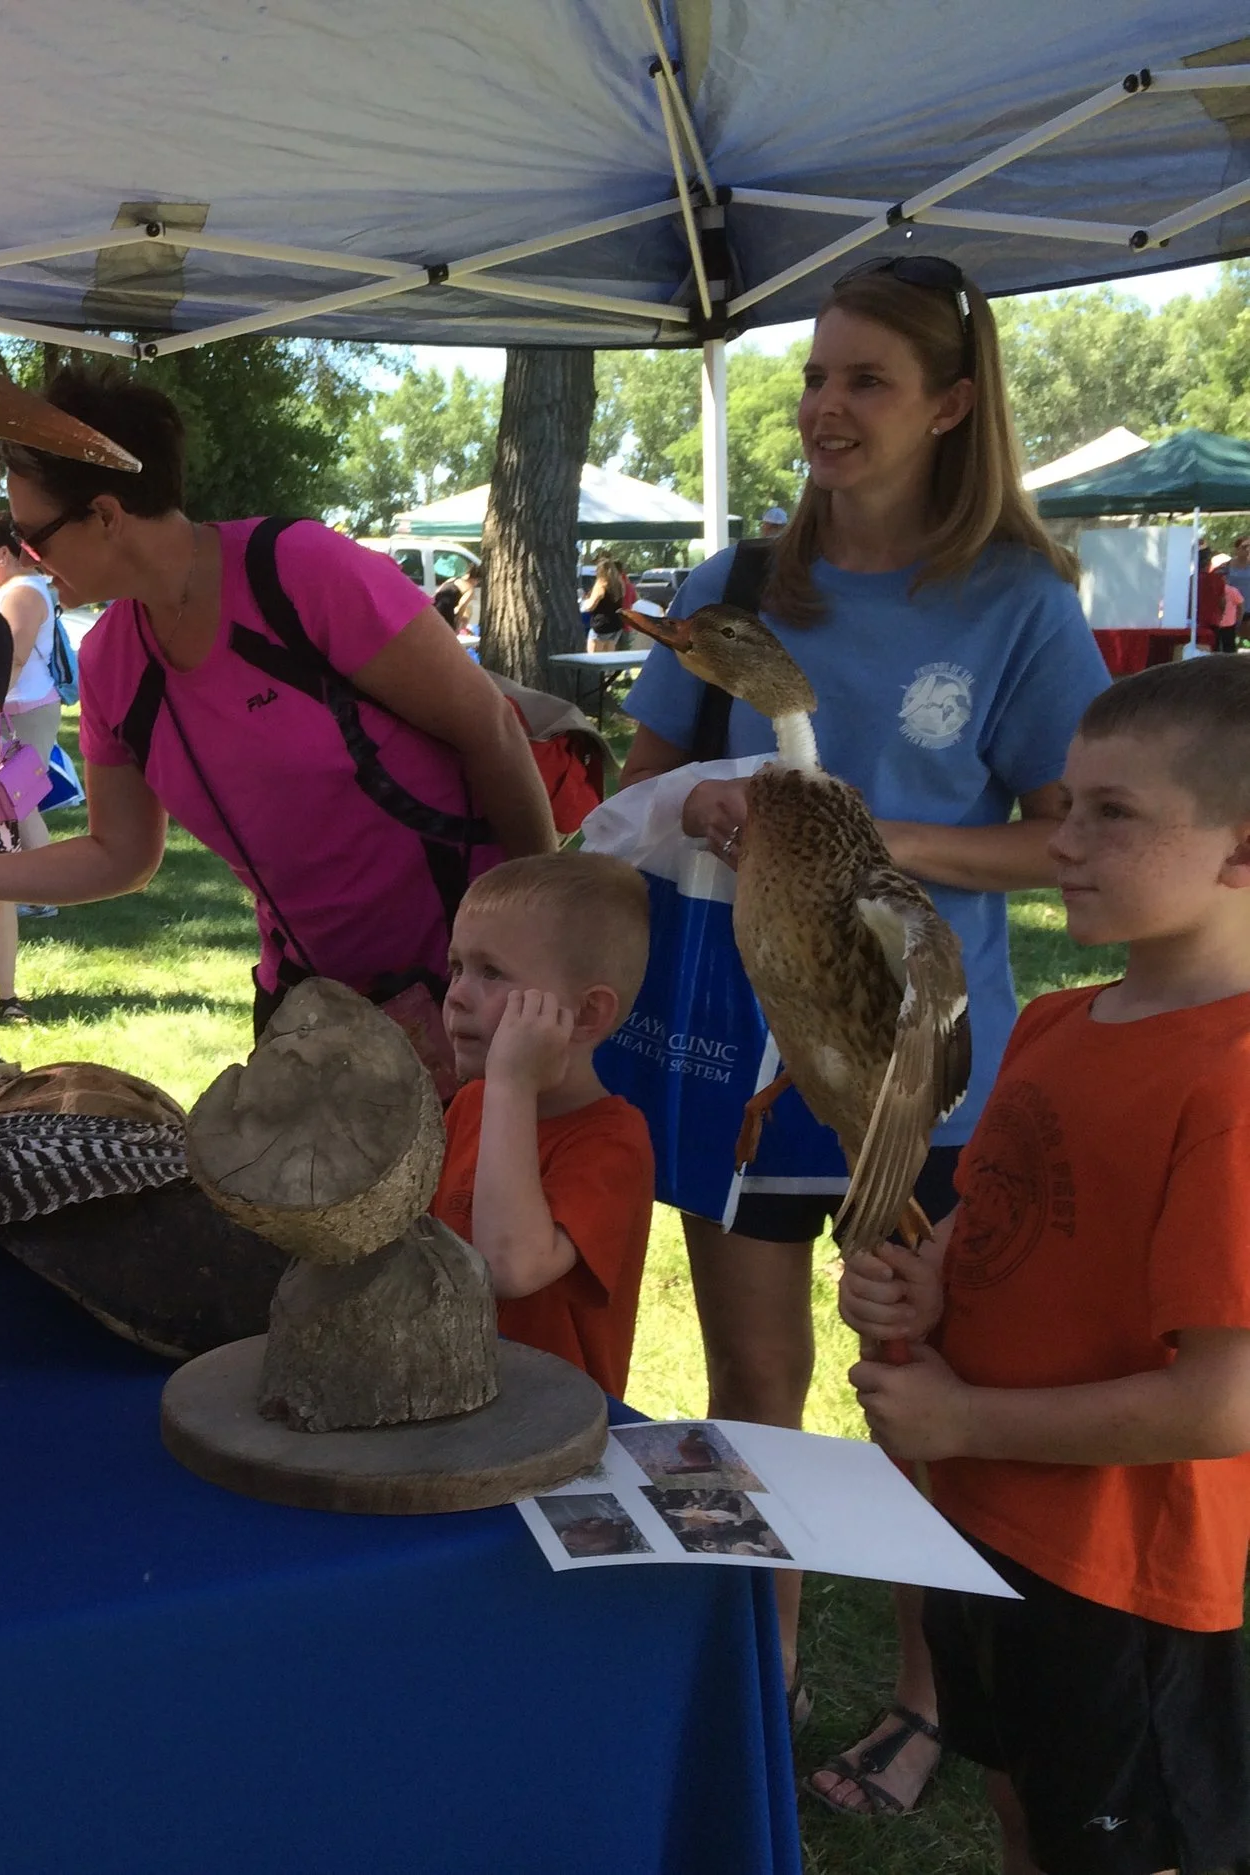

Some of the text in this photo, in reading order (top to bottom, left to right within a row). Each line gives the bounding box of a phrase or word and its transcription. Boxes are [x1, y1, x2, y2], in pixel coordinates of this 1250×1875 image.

[246, 687, 278, 712] FILA
[623, 1011, 739, 1062] MAY CLINIC
